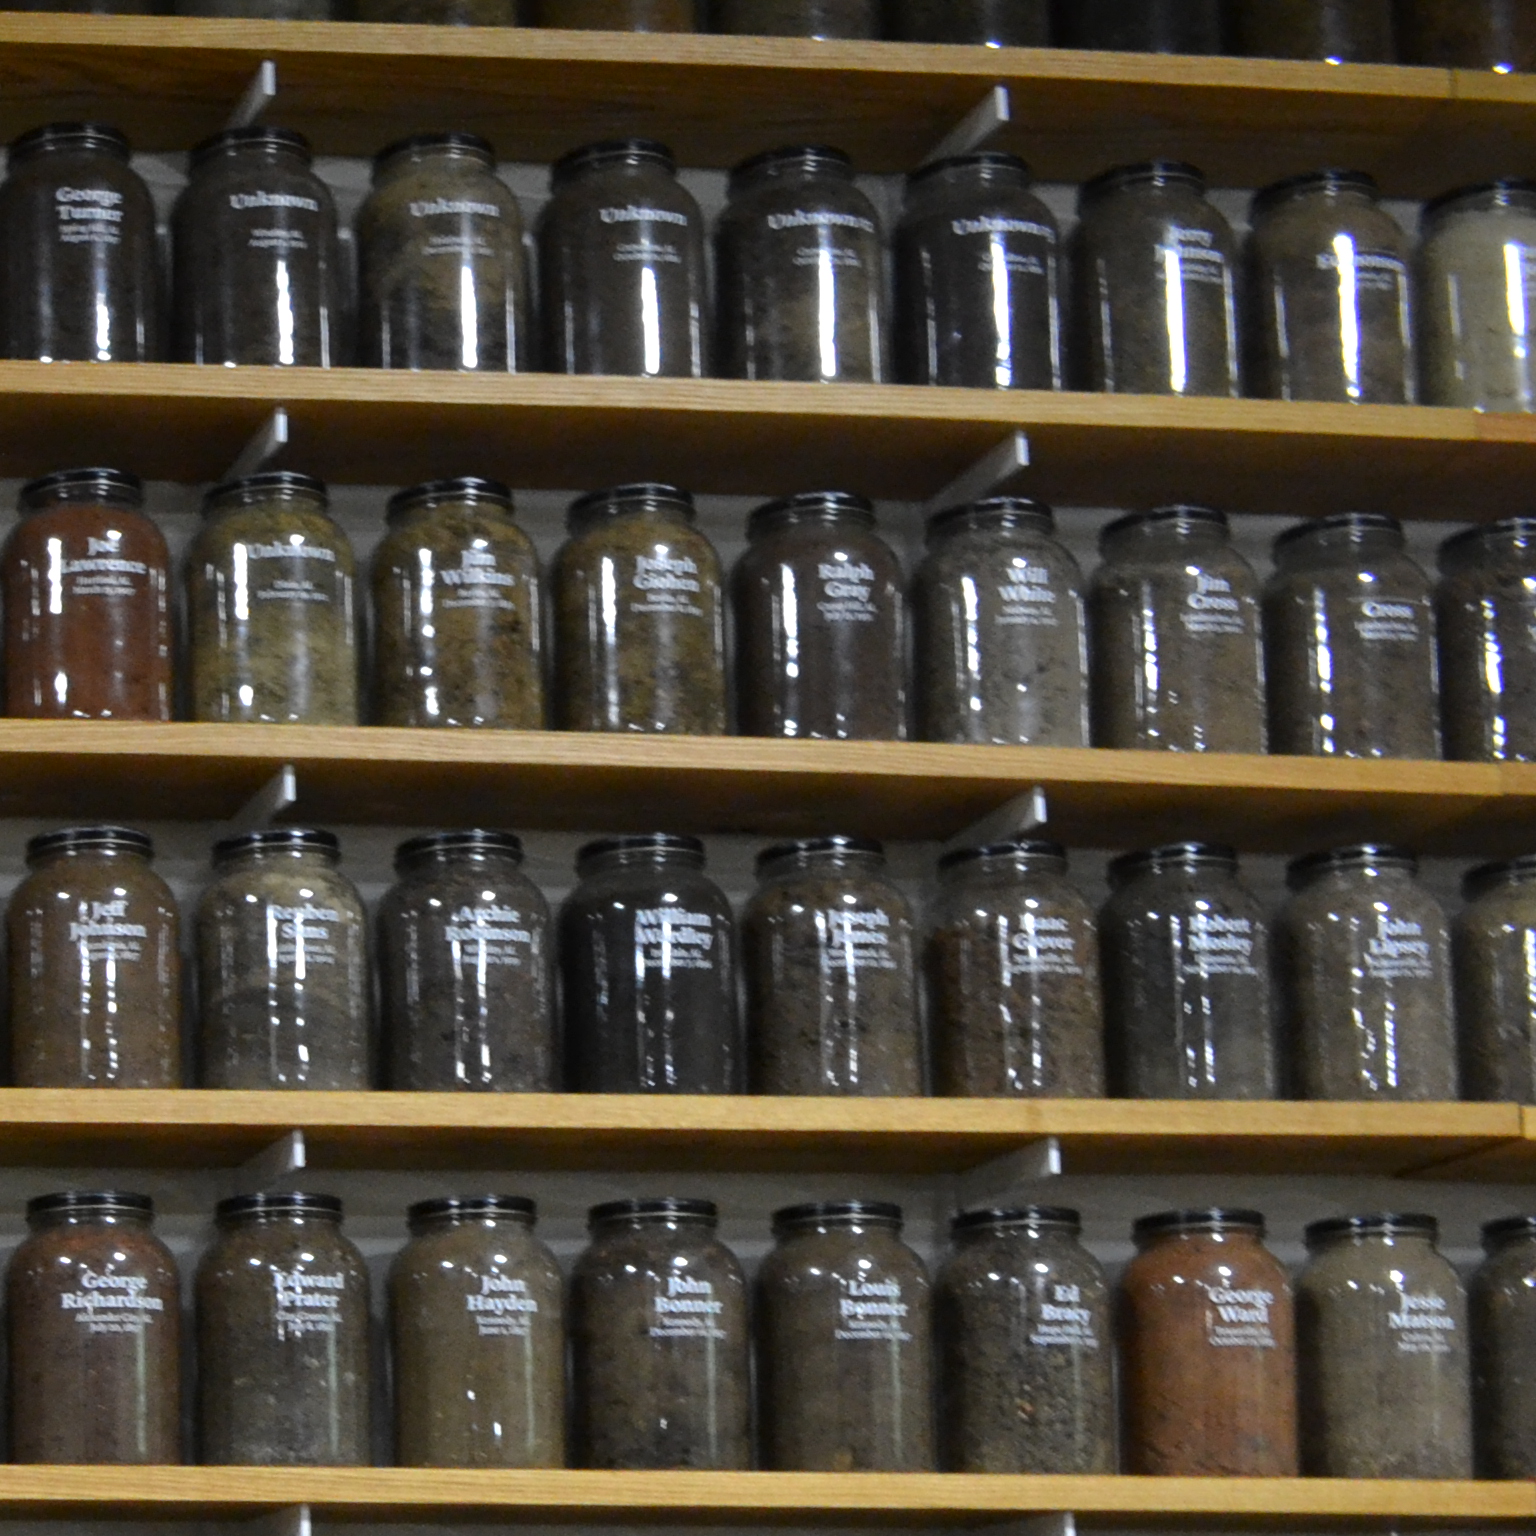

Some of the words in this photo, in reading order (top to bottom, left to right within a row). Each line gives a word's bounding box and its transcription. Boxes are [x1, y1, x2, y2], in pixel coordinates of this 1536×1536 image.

[55, 188, 122, 207] George
[229, 191, 318, 211] Unknown
[56, 206, 123, 223] Turner
[481, 1275, 528, 1294] John
[466, 1294, 538, 1315] Hayden
